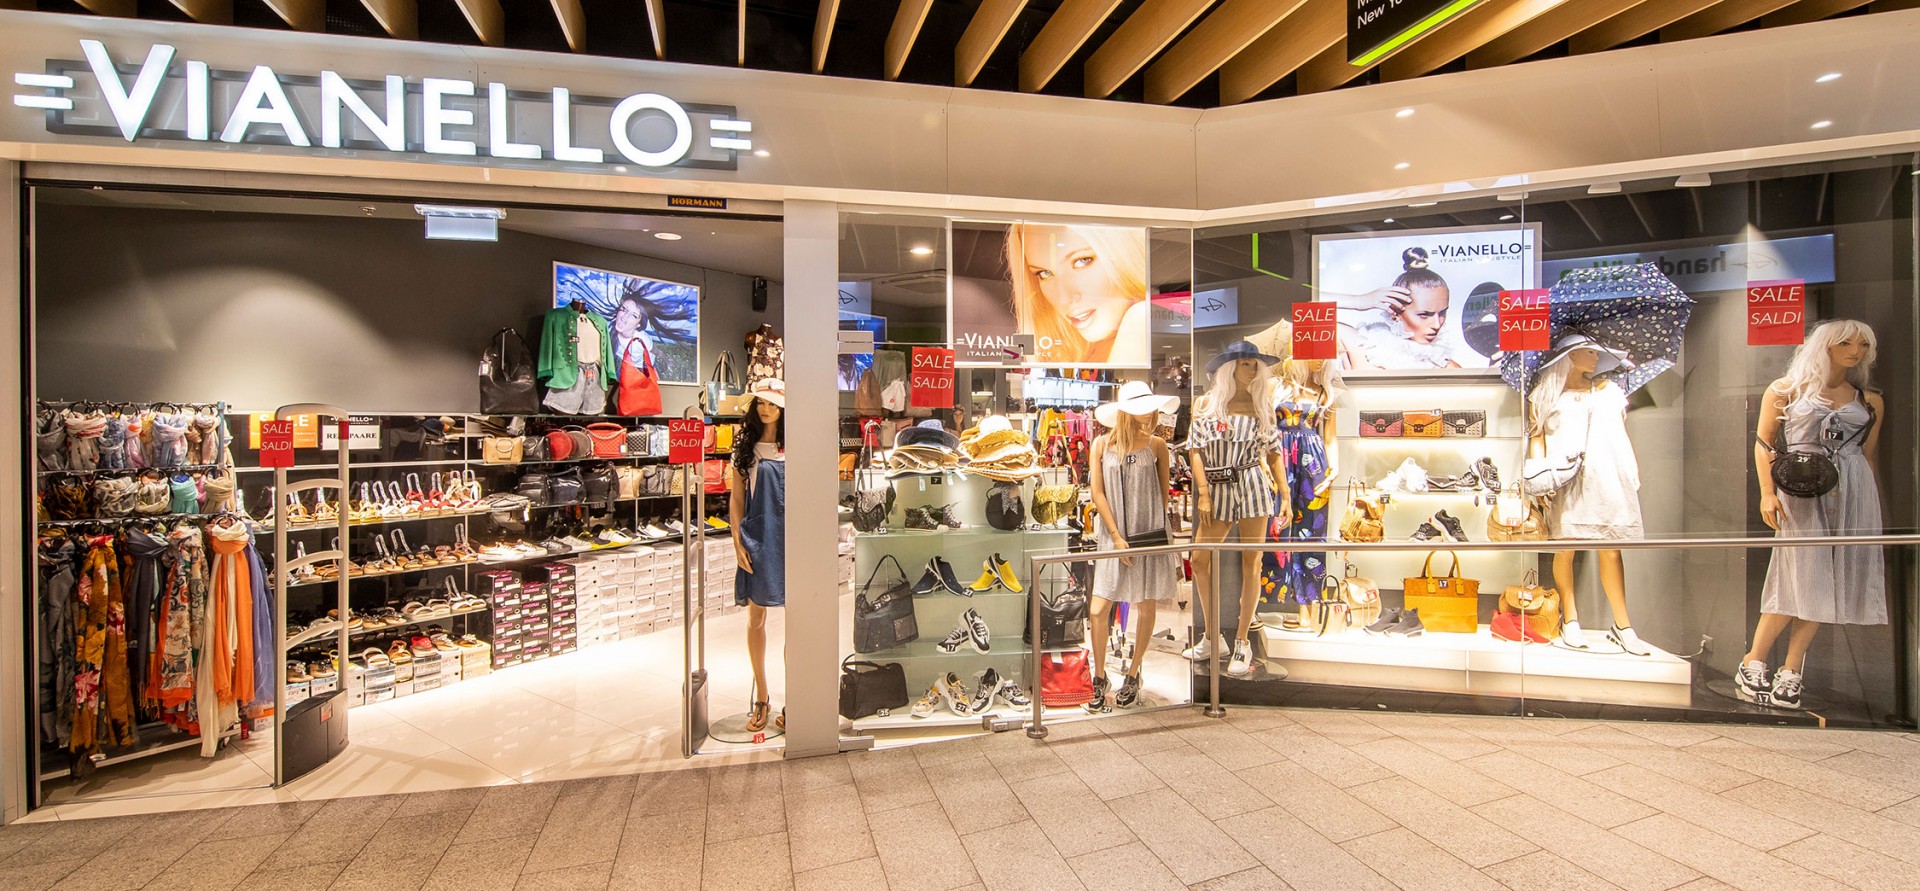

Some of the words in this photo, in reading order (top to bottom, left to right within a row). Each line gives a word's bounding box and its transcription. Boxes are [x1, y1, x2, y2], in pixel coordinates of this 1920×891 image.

[1357, 4, 1385, 30] New
[79, 38, 694, 168] VIANELLO
[1438, 242, 1523, 257] VIANELLO
[1749, 286, 1802, 303] SALE
[1500, 295, 1547, 311] SALE
[1293, 307, 1335, 323] SALE
[1750, 311, 1802, 325] SALDI
[1501, 318, 1548, 332] SALDI
[1294, 330, 1335, 342] SALDI
[913, 353, 953, 369] SALE
[913, 376, 953, 389] SALDI
[262, 422, 292, 434] SALE
[671, 422, 701, 433] SALE
[261, 441, 292, 451] SALDI
[670, 438, 701, 448] SALDI
